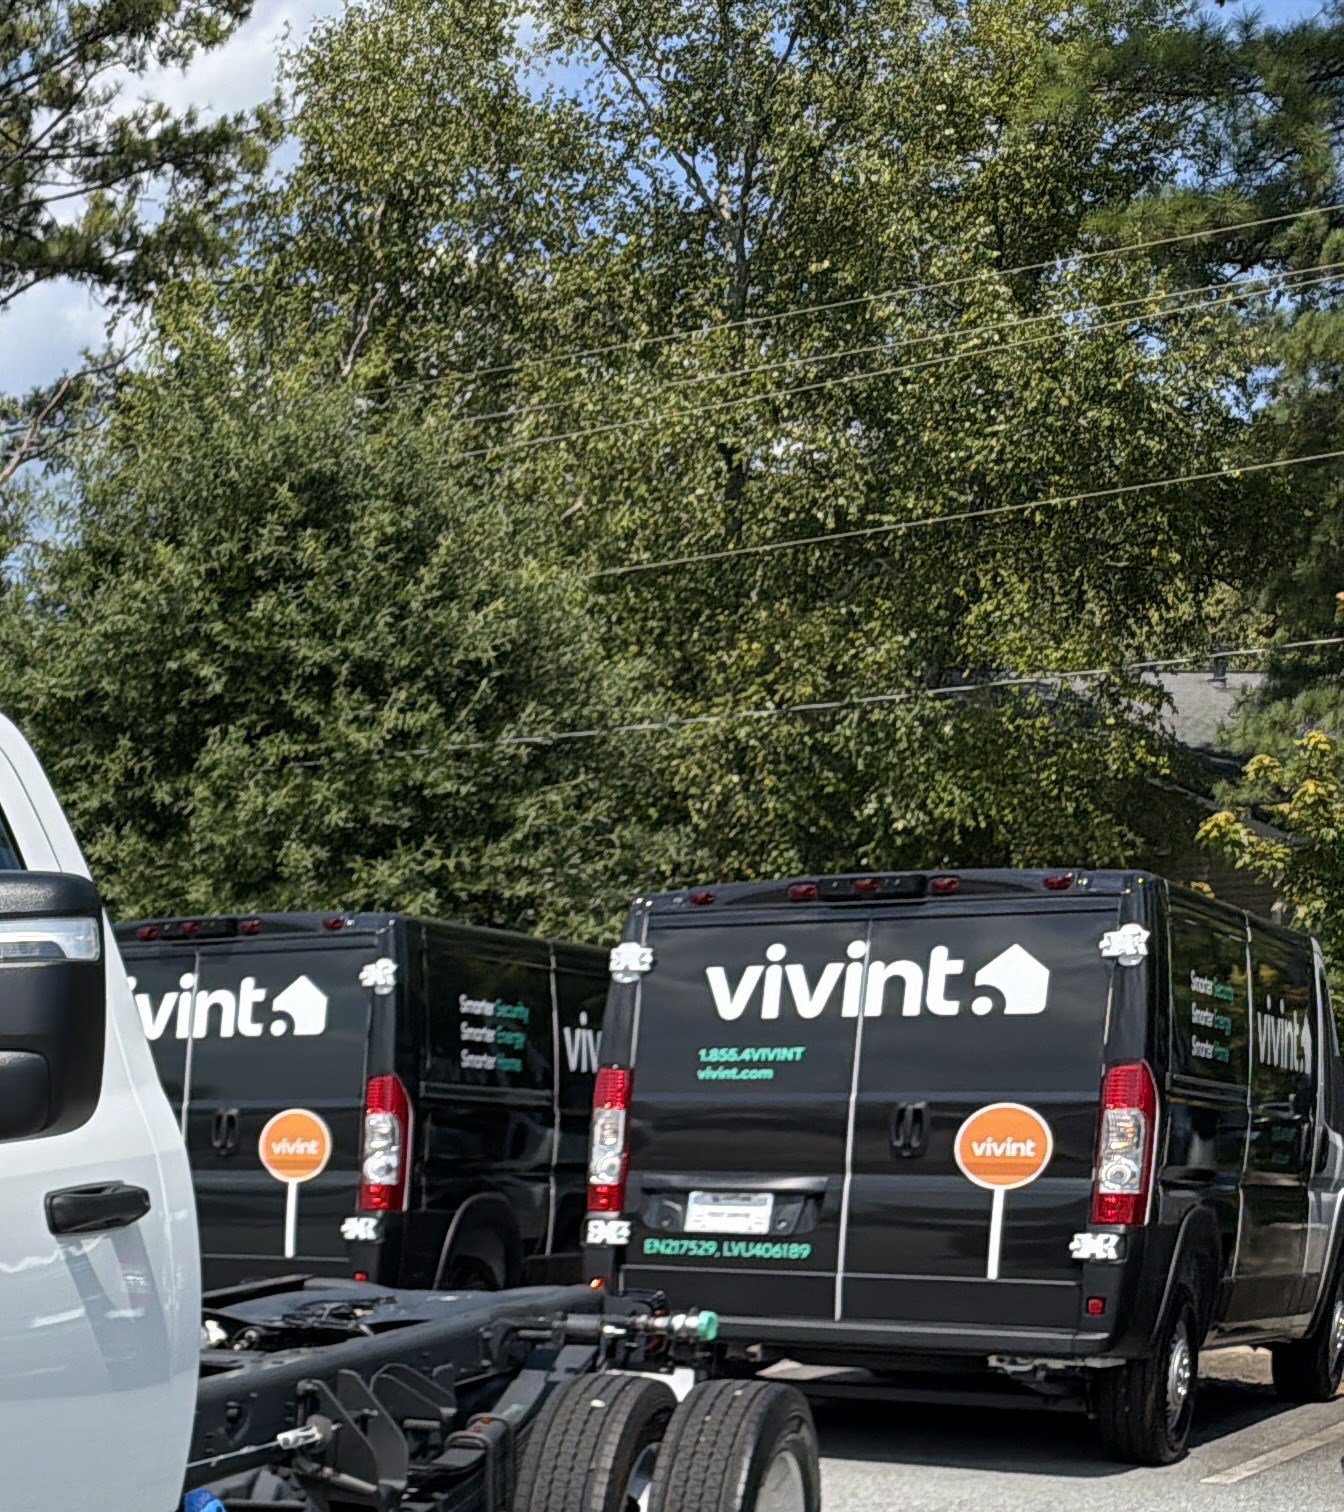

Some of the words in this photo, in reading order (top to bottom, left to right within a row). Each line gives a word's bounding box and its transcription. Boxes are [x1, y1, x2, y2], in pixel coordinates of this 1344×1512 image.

[706, 940, 964, 1020] vivint
[127, 973, 267, 1040] vint
[697, 1066, 773, 1080] vivint.com
[271, 1138, 319, 1155] vivint
[971, 1136, 1037, 1157] vivint
